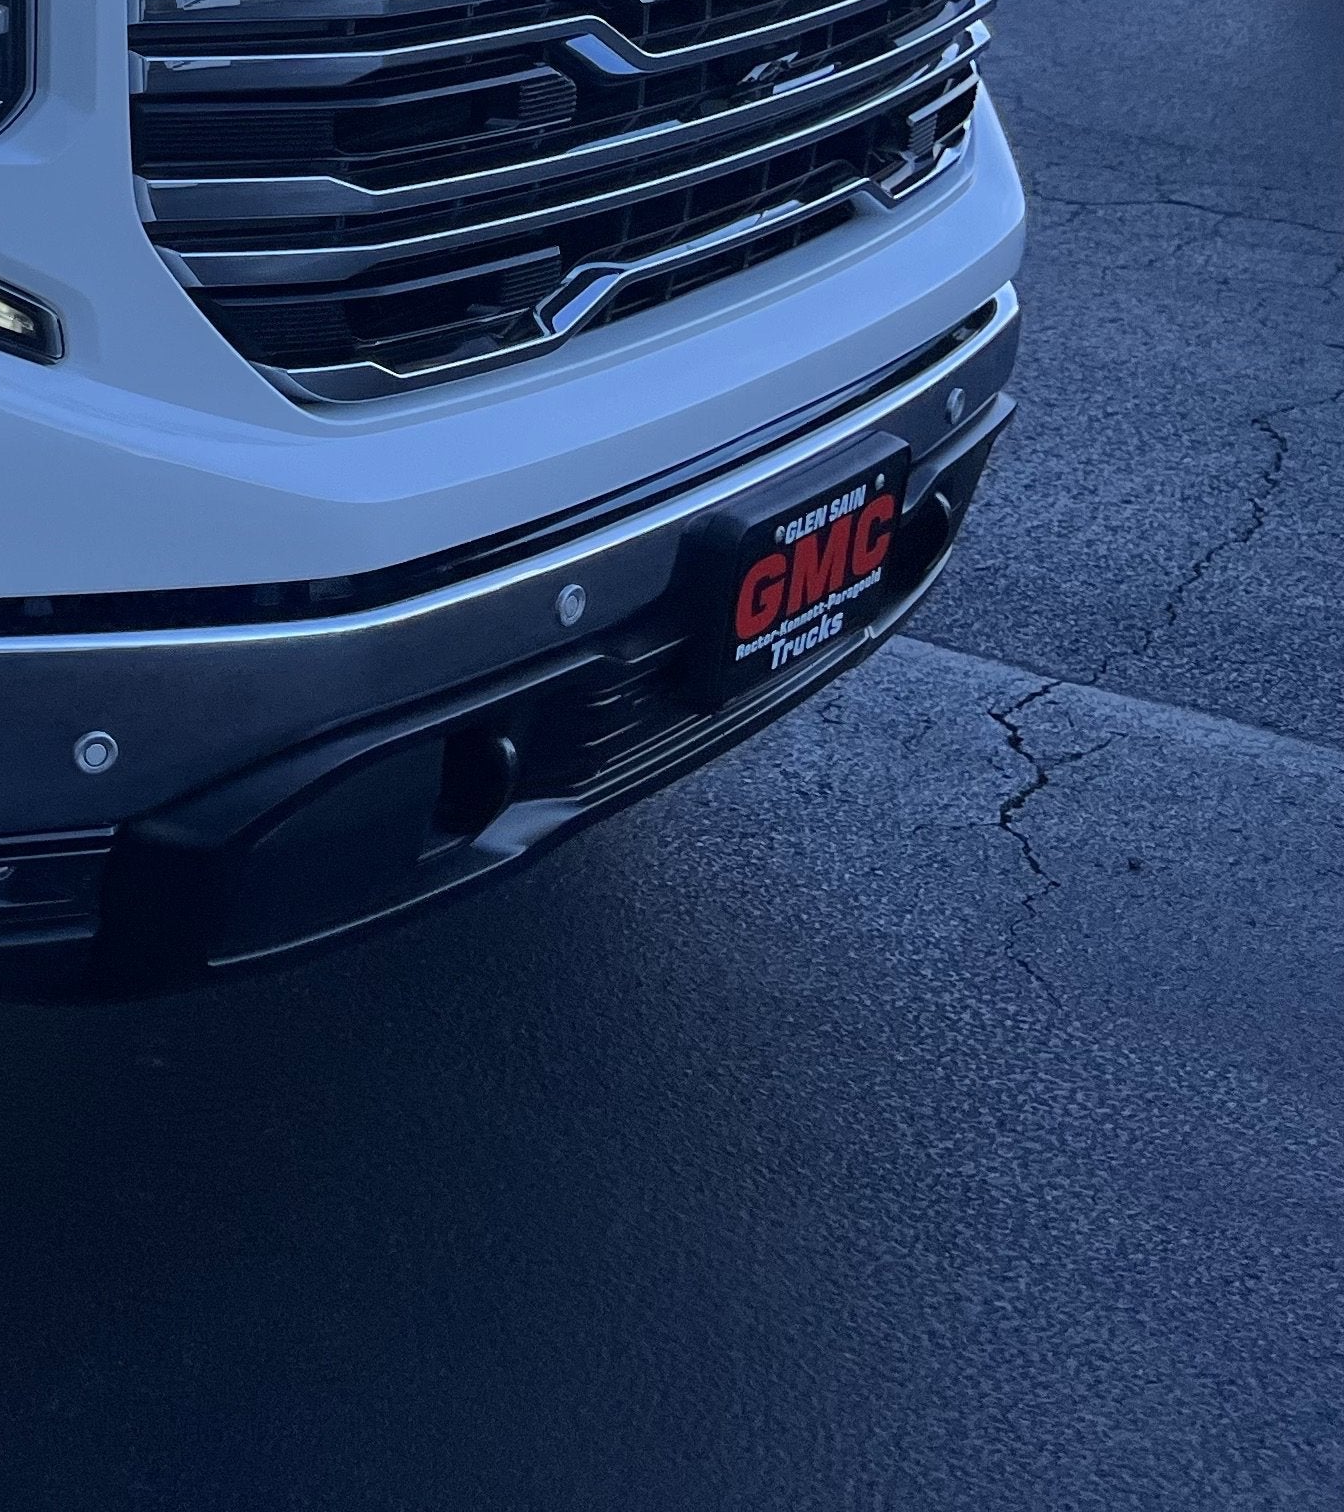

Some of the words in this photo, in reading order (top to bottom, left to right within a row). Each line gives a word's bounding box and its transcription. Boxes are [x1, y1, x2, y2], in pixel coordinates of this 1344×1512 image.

[785, 505, 828, 545] GLEN
[829, 484, 867, 522] SAIN
[735, 493, 895, 639] GMC
[771, 612, 844, 670] Trucks
